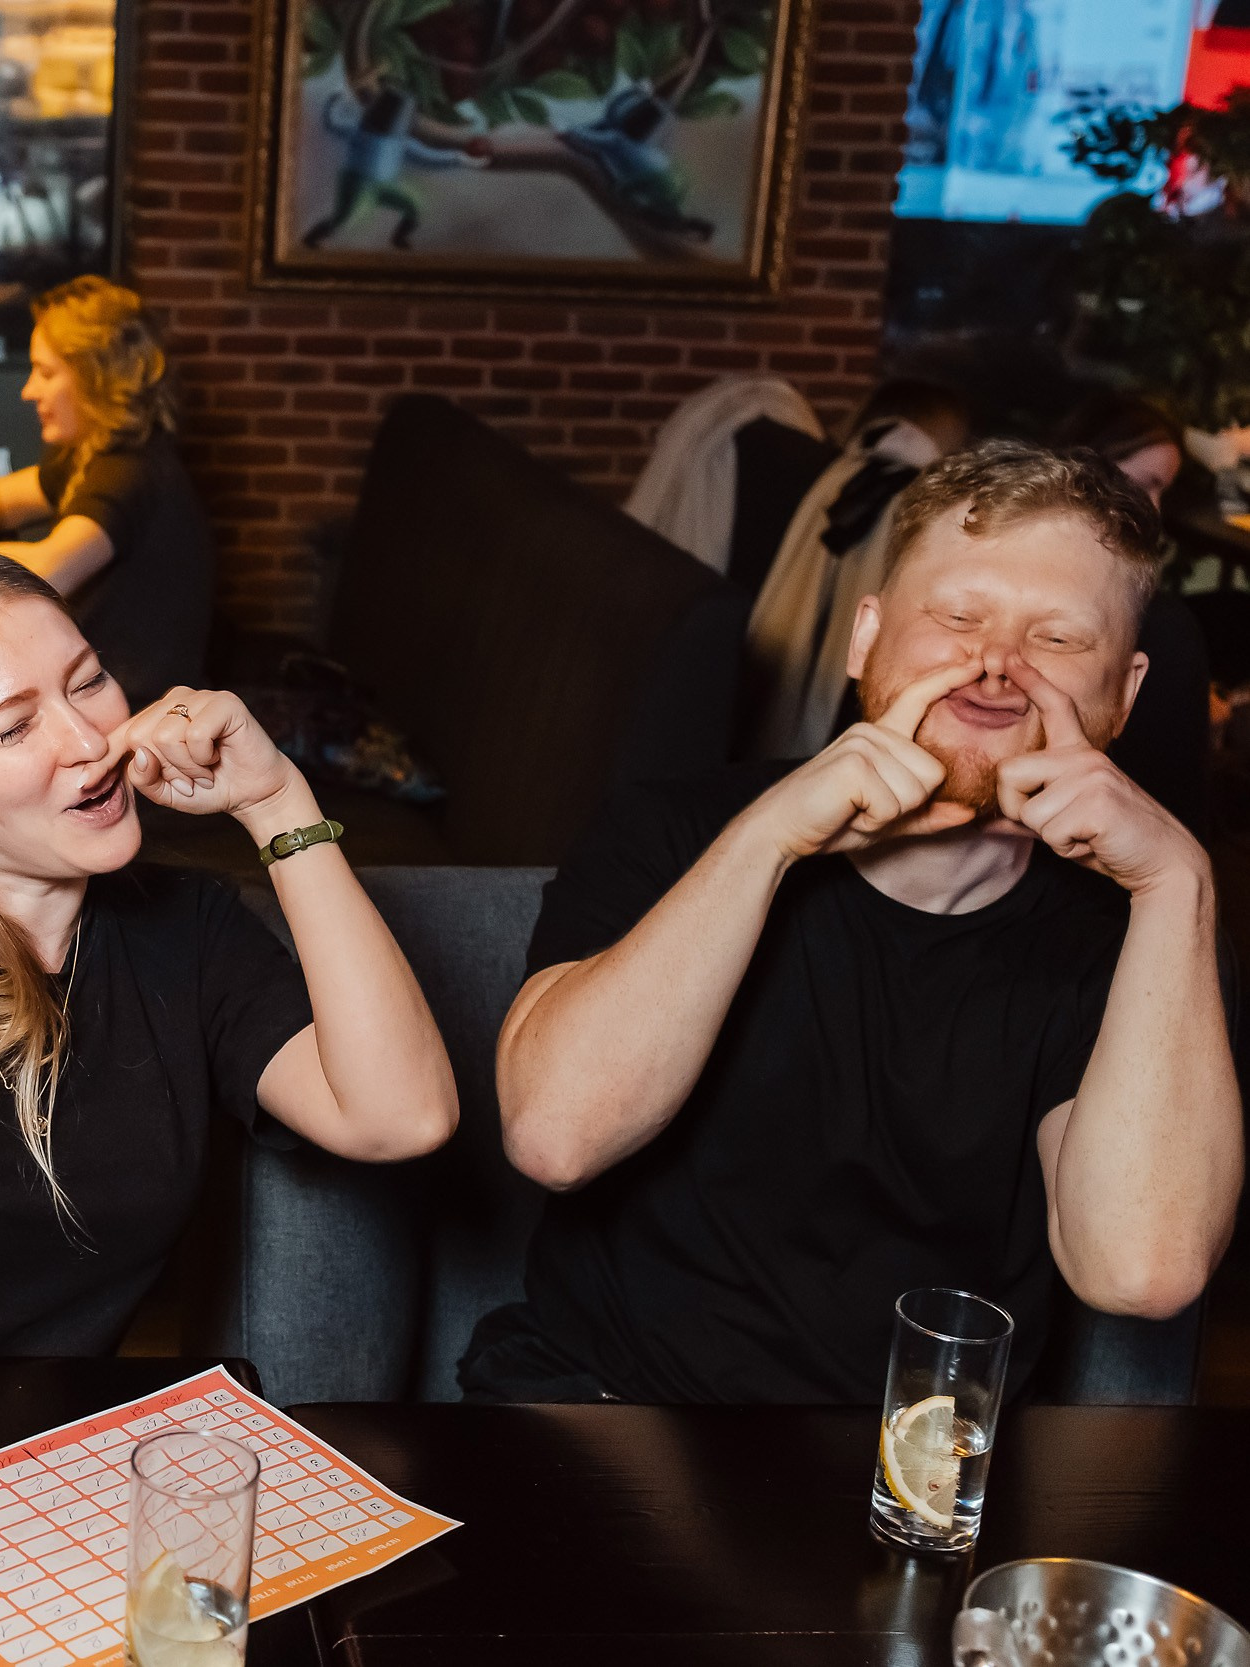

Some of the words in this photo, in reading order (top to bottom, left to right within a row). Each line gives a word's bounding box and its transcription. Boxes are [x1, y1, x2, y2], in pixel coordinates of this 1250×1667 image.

[27, 1476, 43, 1492] 2
[268, 1556, 287, 1571] 2
[325, 1555, 357, 1572] ВТОРОЙ
[284, 1572, 317, 1588] ТРЕТИЙ
[248, 1587, 280, 1603] ЧЕТВЕР
[85, 1635, 102, 1649] 2
